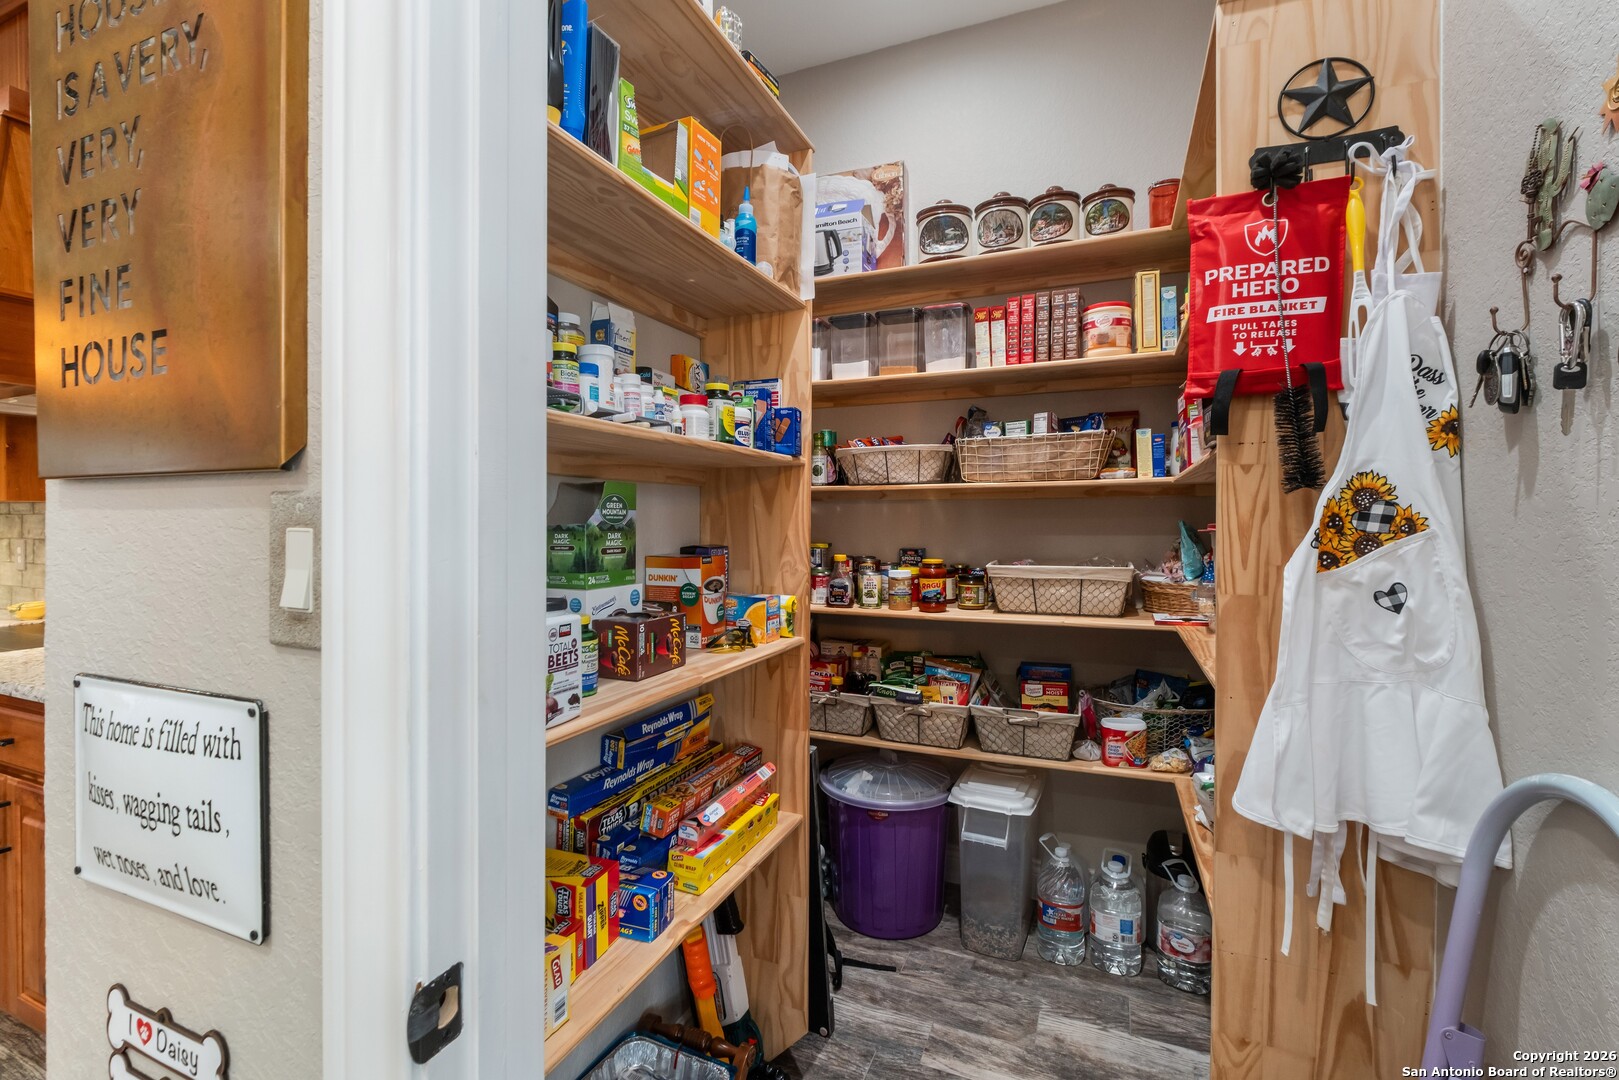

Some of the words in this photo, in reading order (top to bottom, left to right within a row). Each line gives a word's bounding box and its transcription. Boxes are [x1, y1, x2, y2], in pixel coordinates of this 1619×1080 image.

[56, 0, 165, 53] HOU
[56, 72, 79, 120] IS
[87, 61, 110, 108] A
[113, 12, 209, 93] VERY,
[56, 115, 144, 187] VERY,
[57, 187, 142, 253] VERY
[837, 217, 858, 225] Beach
[1205, 256, 1330, 286] PREPARED
[60, 263, 133, 321] FINE
[1232, 277, 1300, 299] HERO
[1213, 307, 1246, 318] FIRE
[1250, 300, 1318, 314] BLANKET
[1232, 322, 1258, 331] PULL
[1250, 329, 1297, 339] RELEASE
[60, 329, 168, 389] HOUSE
[560, 369, 577, 378] Biotin
[588, 576, 596, 585] 24
[648, 574, 678, 582] DUNKIN'
[547, 650, 579, 669] BEETS
[549, 641, 572, 654] TOTAL
[83, 702, 105, 738] This
[106, 710, 140, 746] home
[142, 717, 155, 749] is
[157, 718, 200, 756] filled
[202, 726, 242, 760] with
[641, 716, 669, 735] Reynolds
[667, 711, 684, 722] Wrap
[581, 765, 616, 782] Reyn
[602, 766, 637, 790] Reynolds
[636, 758, 655, 774] Wrap
[123, 792, 182, 837] wagging
[602, 809, 624, 828] TEXAS
[93, 846, 116, 869] wet
[157, 863, 184, 892] and
[552, 959, 562, 986] GLAD
[128, 1013, 133, 1036] I
[156, 1027, 199, 1077] Daisy
